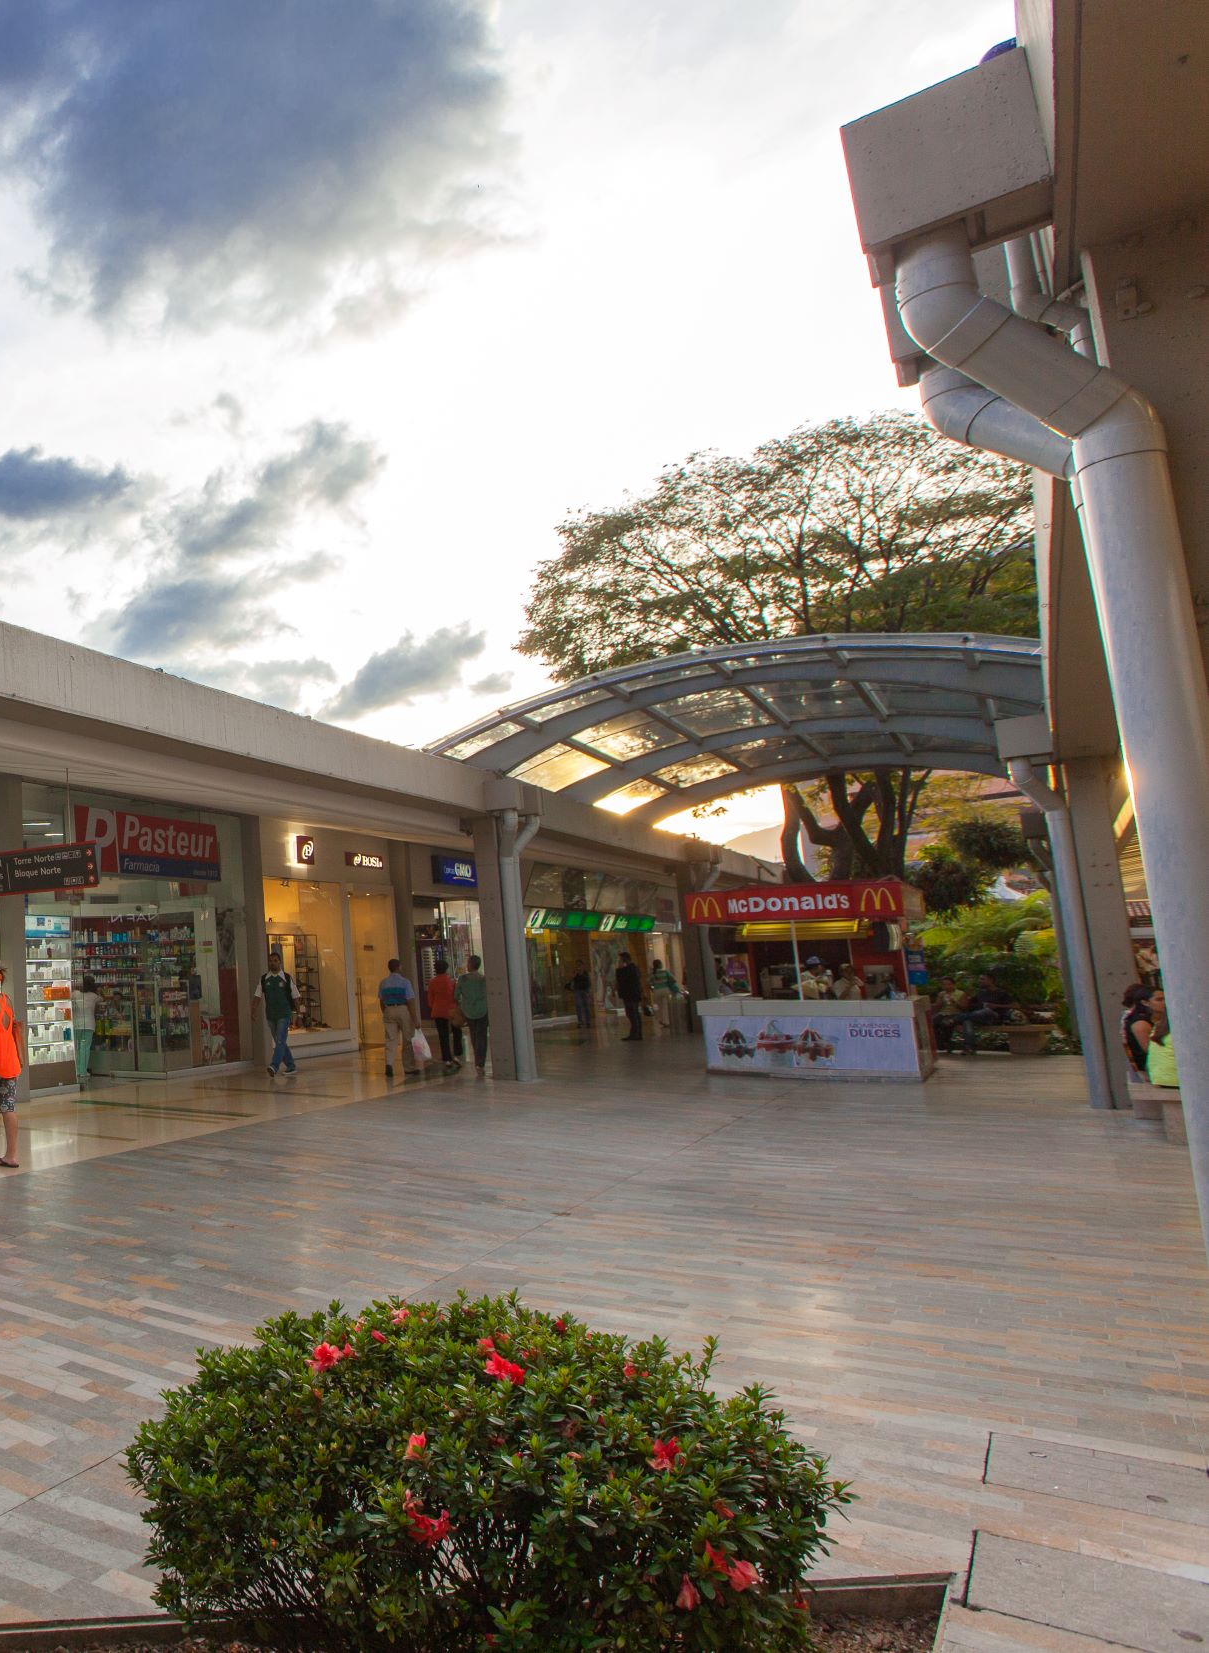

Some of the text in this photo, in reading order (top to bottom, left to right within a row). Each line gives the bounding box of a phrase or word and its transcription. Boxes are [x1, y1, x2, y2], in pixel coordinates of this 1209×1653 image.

[122, 815, 213, 858] Pasteur
[14, 854, 55, 866] Torre Norte
[123, 858, 160, 873] Farmacia
[14, 866, 61, 878] Bloque Norte
[454, 863, 472, 878] GMO
[727, 893, 850, 914] McDonald's
[850, 1028, 901, 1038] DULCES
